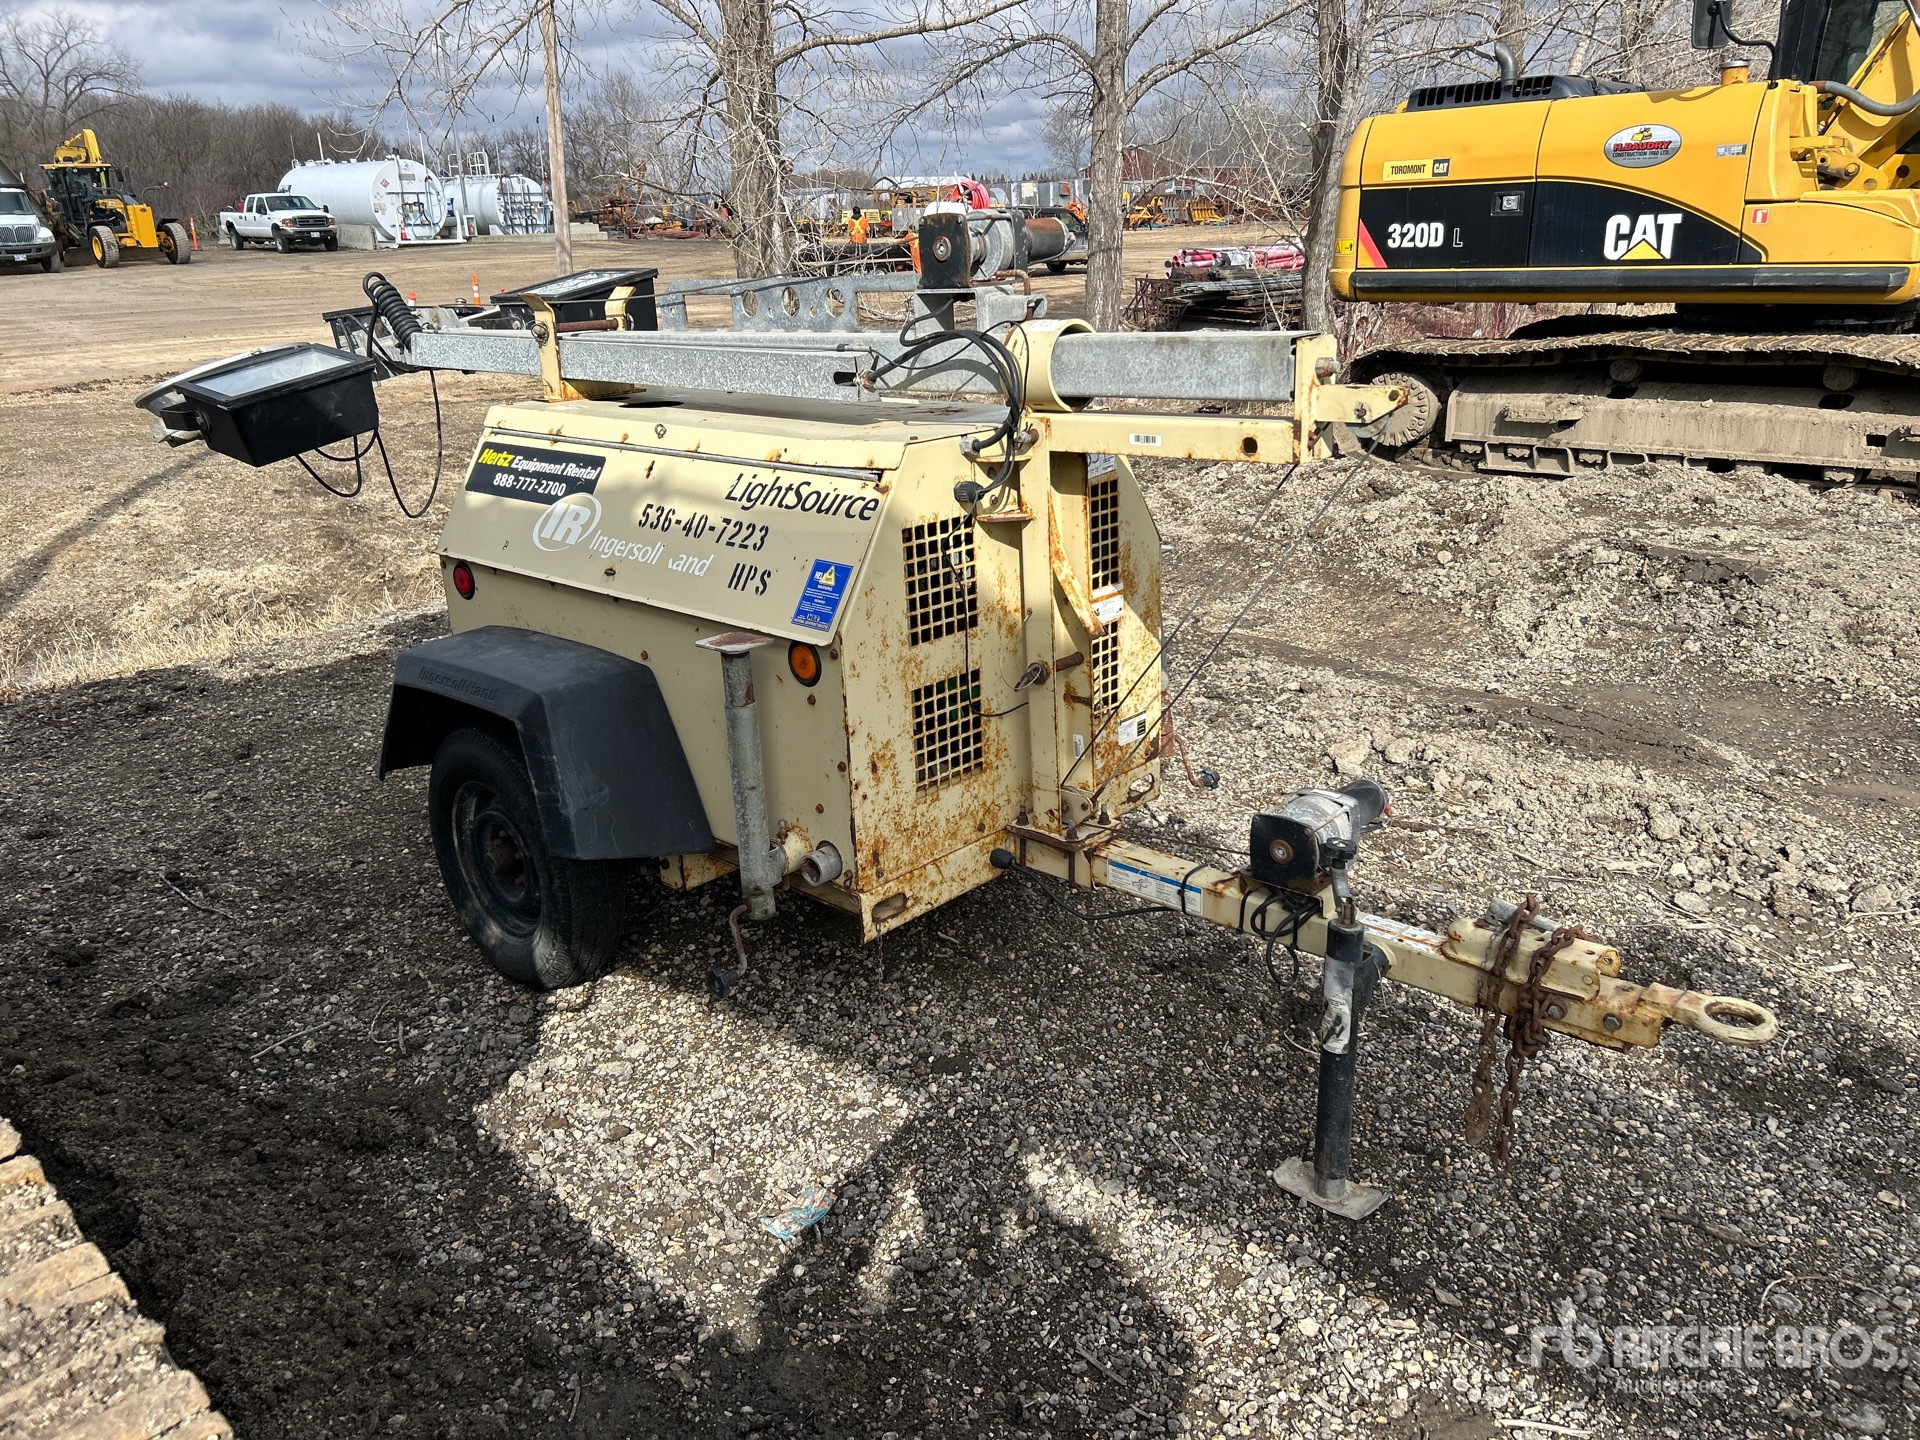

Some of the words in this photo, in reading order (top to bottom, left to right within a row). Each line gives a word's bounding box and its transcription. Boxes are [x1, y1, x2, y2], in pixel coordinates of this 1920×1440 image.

[1613, 141, 1672, 152] H.BAUDRY
[1391, 164, 1426, 175] TOROMONT
[1433, 163, 1449, 174] CAT
[1387, 222, 1444, 248] 320D
[1452, 228, 1464, 248] L
[1603, 213, 1683, 260] CAT
[478, 448, 515, 468] Hertz
[511, 456, 565, 475] Equipment
[563, 463, 601, 480] Rental
[493, 473, 567, 497] 888-777-2700
[724, 473, 880, 521] LightSource
[540, 501, 592, 545] IR
[638, 503, 769, 552] 536-40-7223
[588, 529, 665, 565] Ingersoll
[668, 554, 715, 577] and
